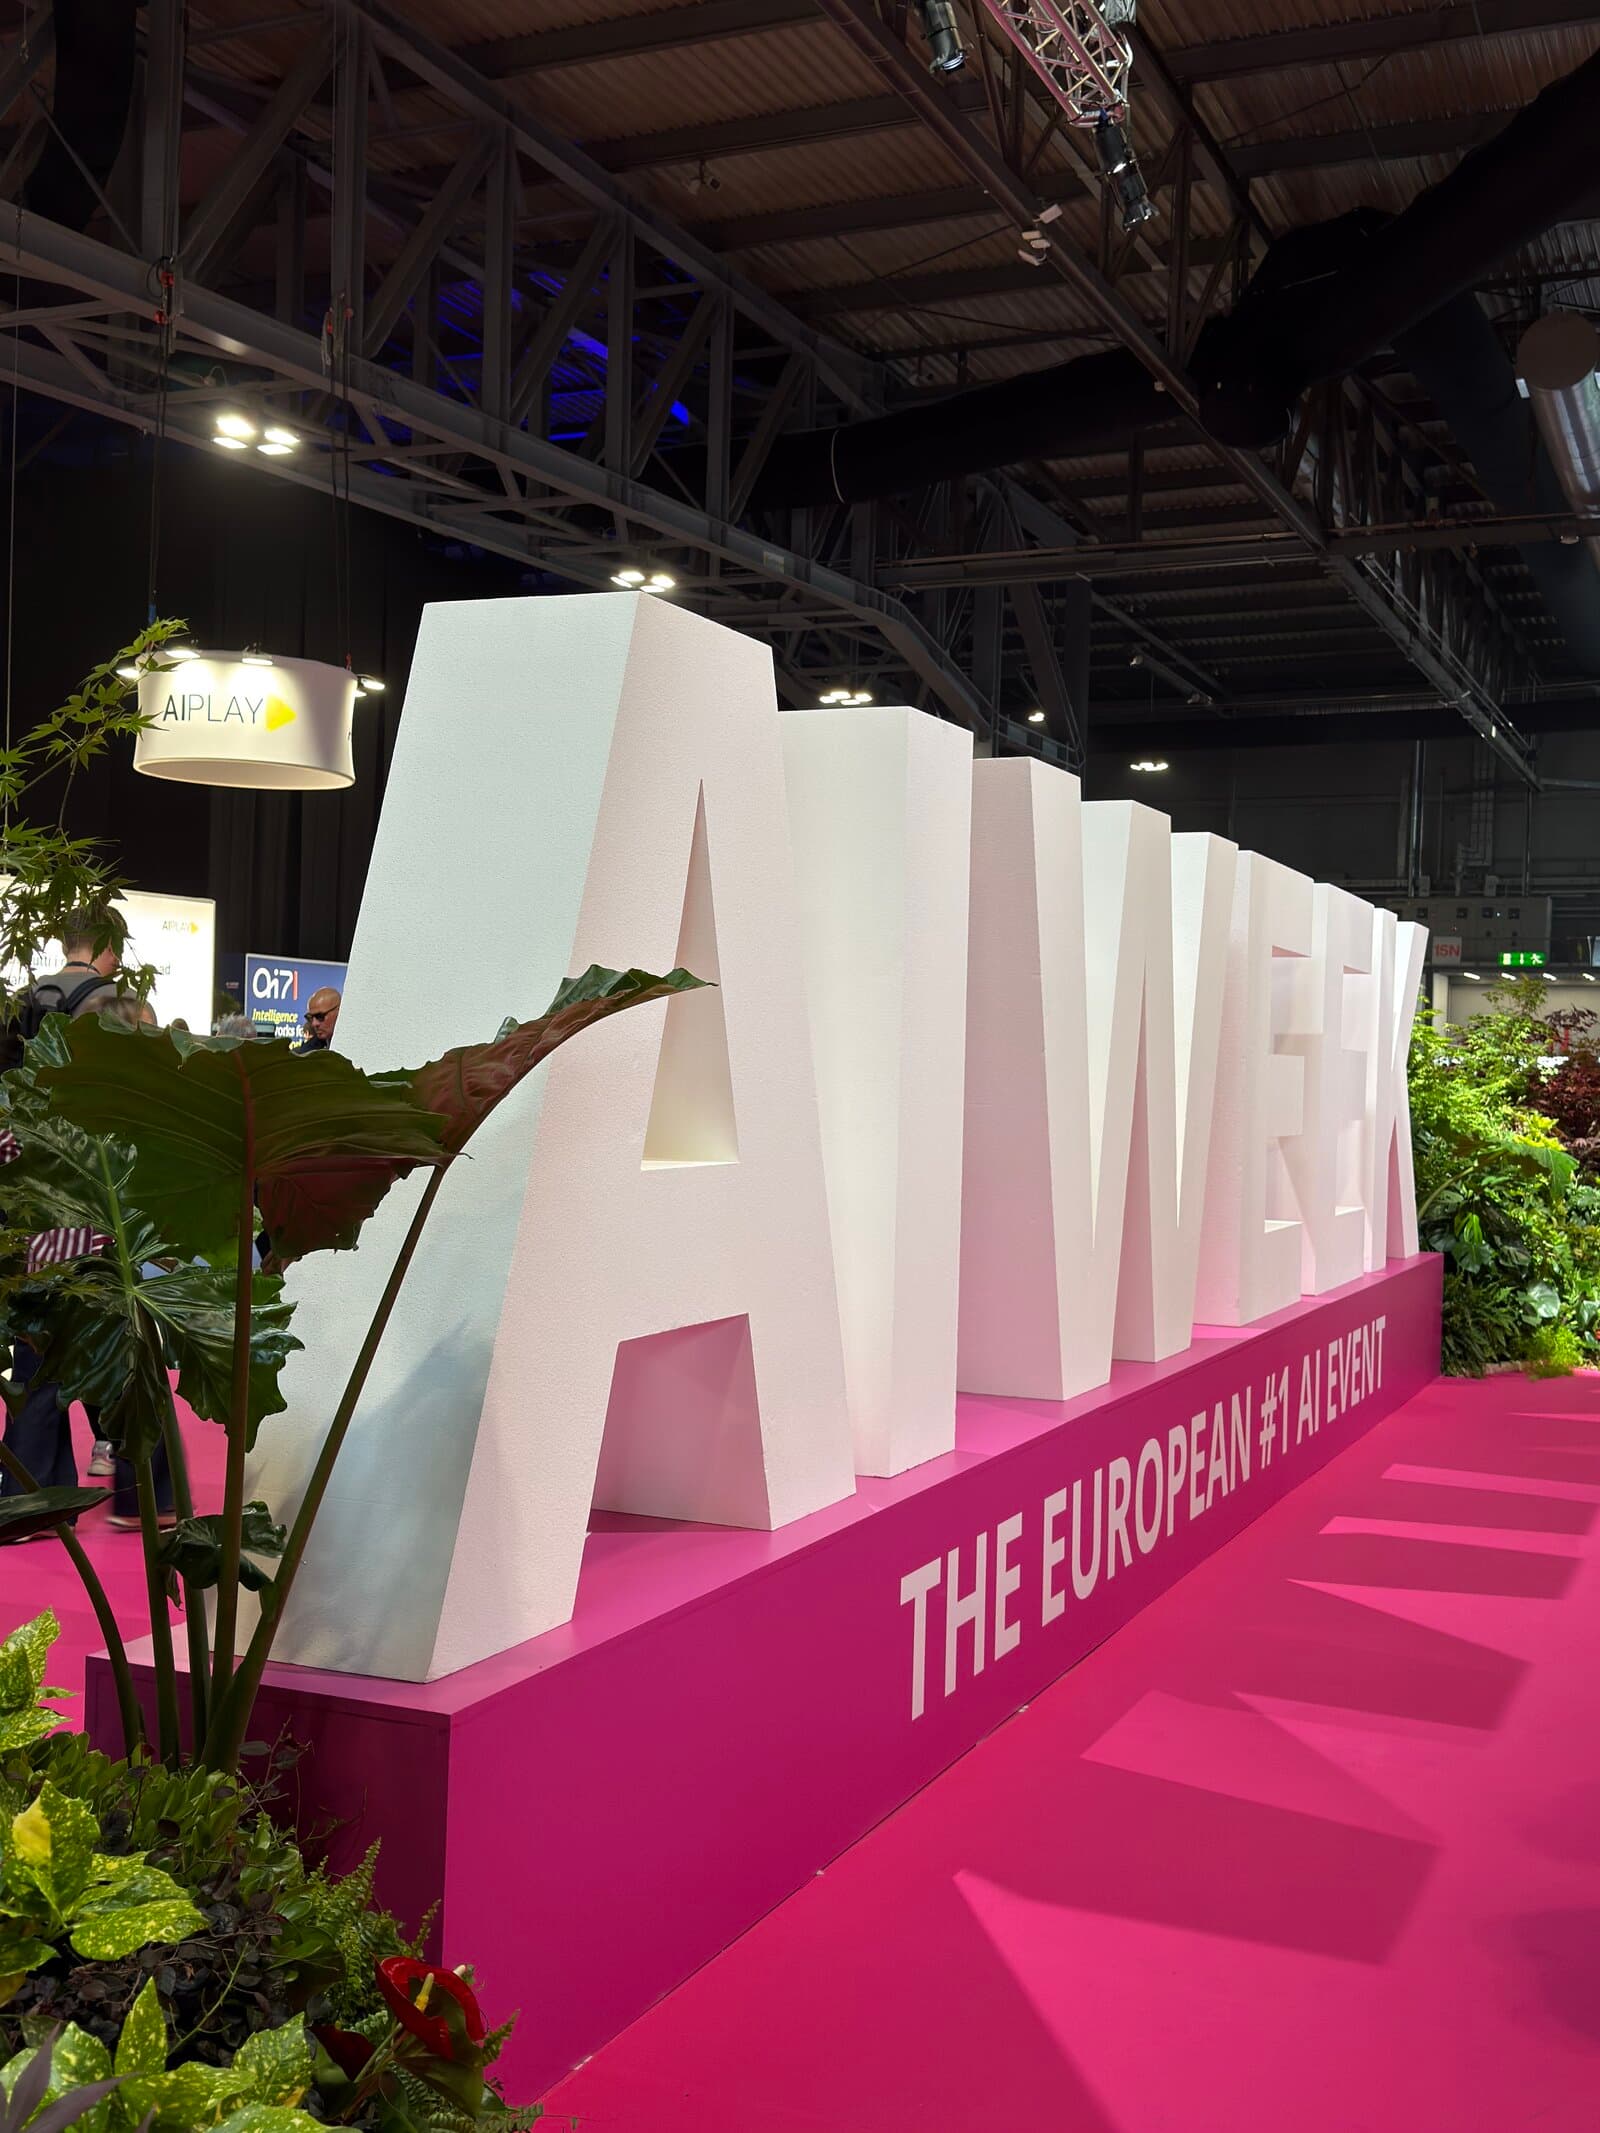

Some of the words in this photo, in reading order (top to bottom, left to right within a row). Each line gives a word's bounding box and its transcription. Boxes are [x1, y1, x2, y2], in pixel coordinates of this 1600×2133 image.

[162, 694, 264, 724] AIPLAY
[420, 592, 974, 1682] AI
[1020, 756, 1430, 1401] WEEK
[900, 1511, 1023, 1721] THE
[1041, 1385, 1252, 1627] EUROPEAN
[1259, 1366, 1289, 1470] #1
[1296, 1349, 1321, 1445] AI
[1327, 1315, 1386, 1424] EVENT
